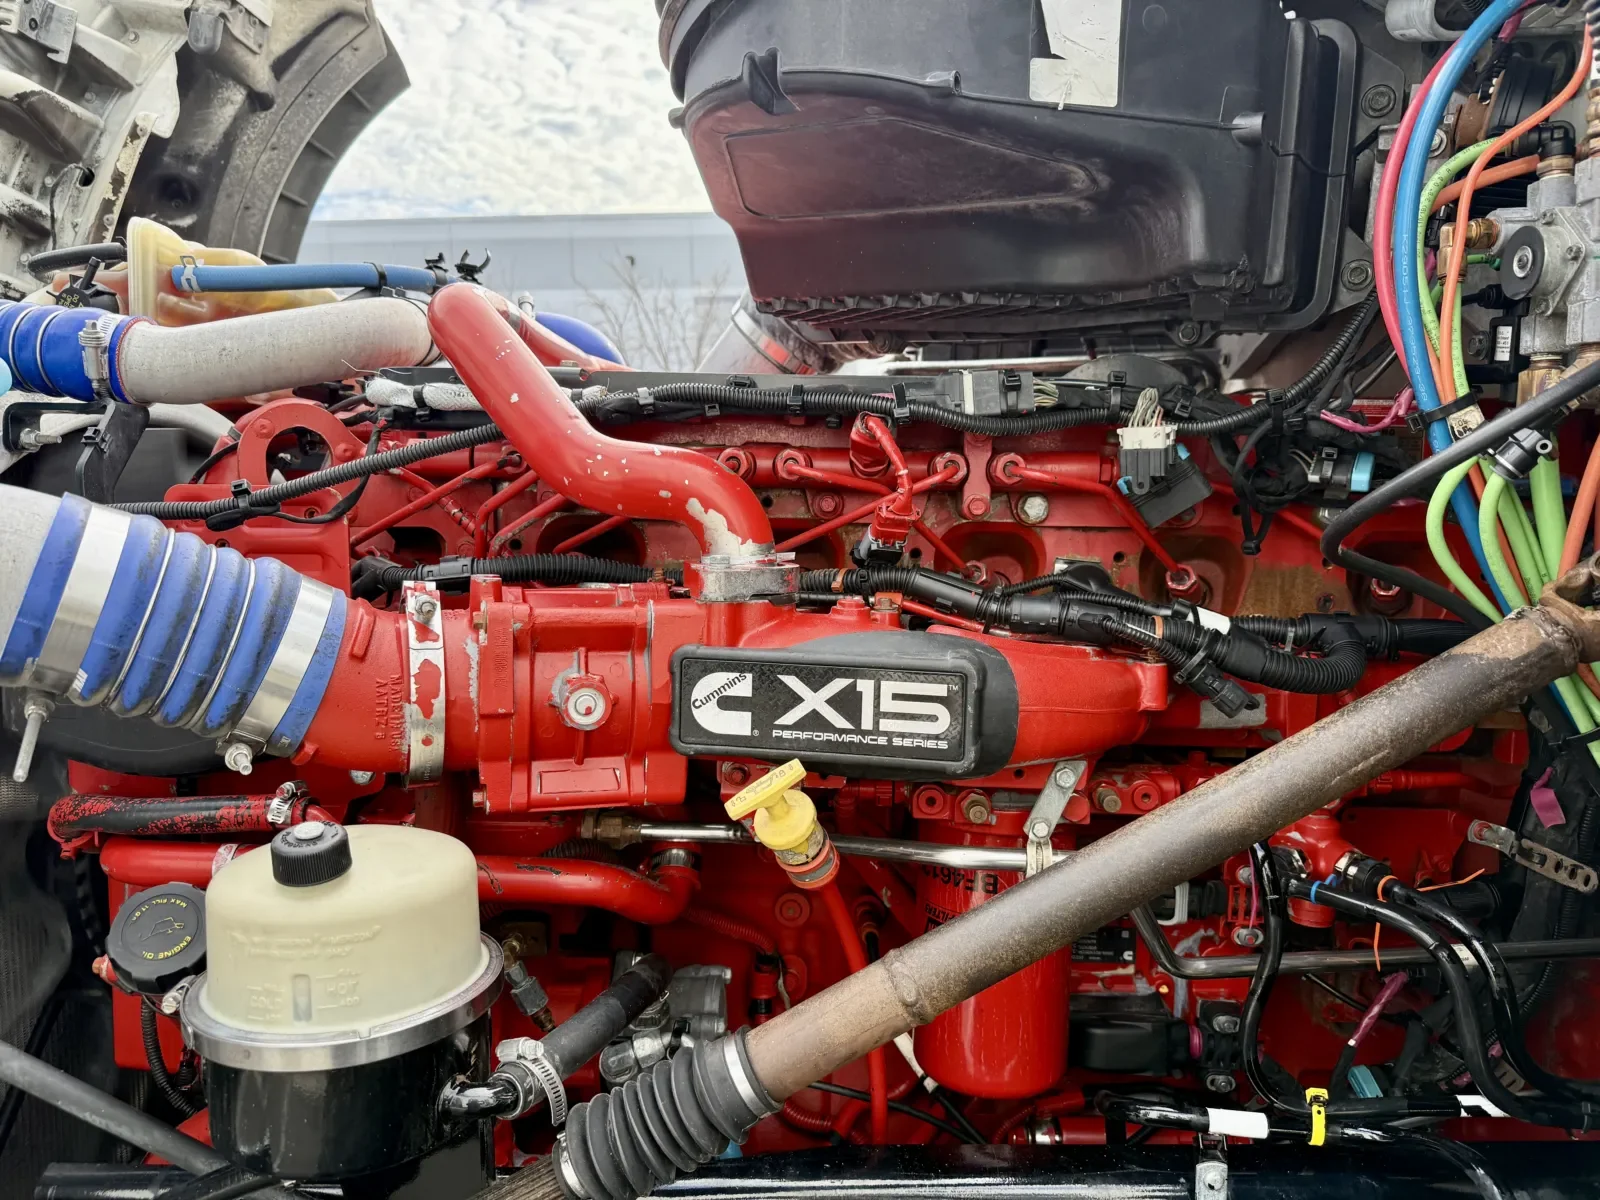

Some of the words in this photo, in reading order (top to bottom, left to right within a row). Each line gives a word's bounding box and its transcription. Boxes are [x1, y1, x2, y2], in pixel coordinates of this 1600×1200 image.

[691, 671, 747, 710] Cummins
[773, 675, 951, 735] X15
[772, 729, 888, 745] PERFORMANCE
[892, 737, 949, 750] SERIES
[170, 898, 188, 908] MAX
[157, 935, 193, 959] ENGINE
[326, 980, 359, 995] HOT
